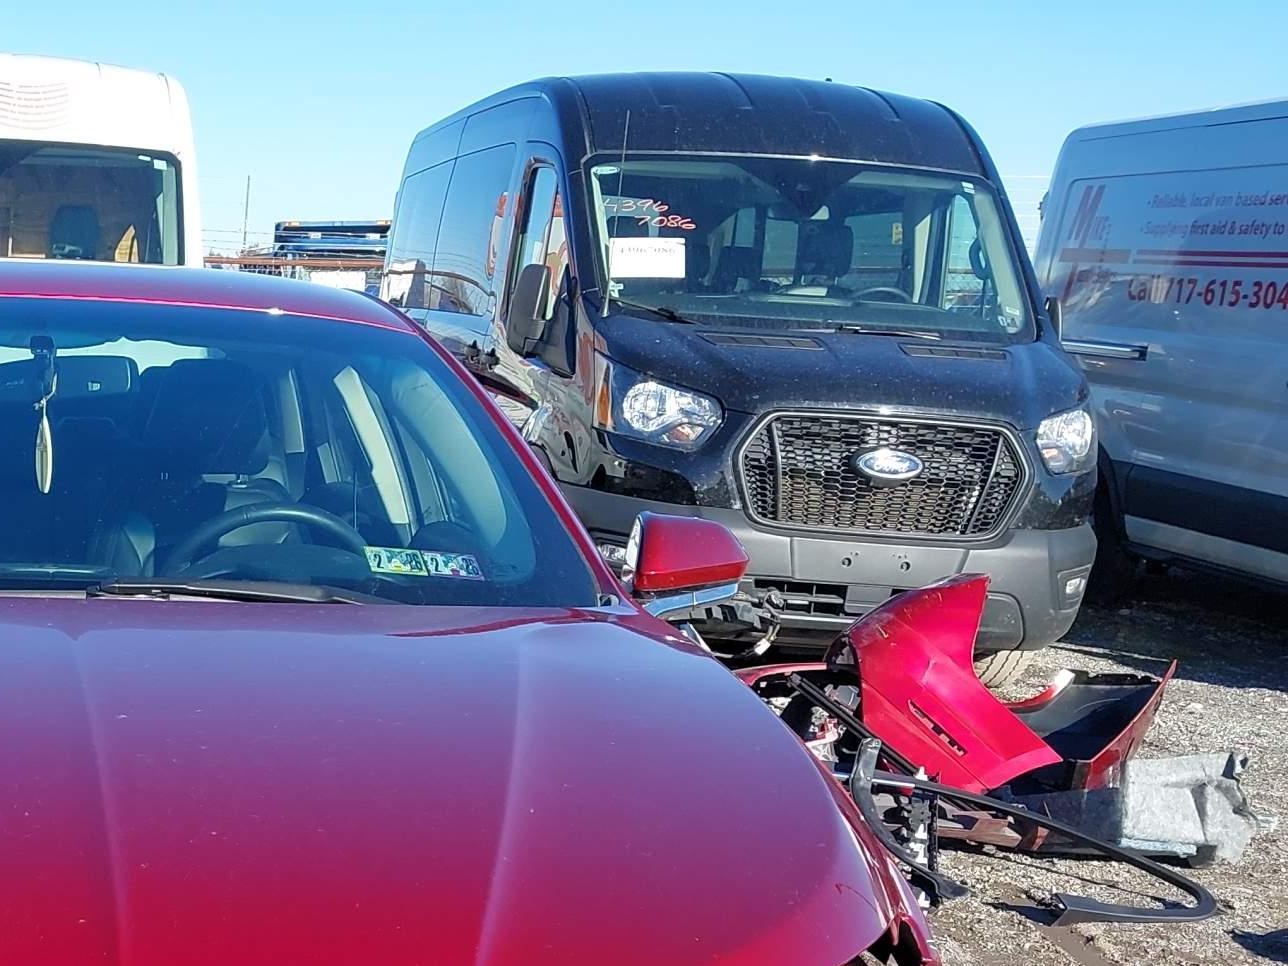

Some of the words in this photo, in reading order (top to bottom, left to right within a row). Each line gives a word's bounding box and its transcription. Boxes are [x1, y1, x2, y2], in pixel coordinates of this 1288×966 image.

[603, 198, 668, 213] 4396
[1191, 192, 1215, 206] local
[1216, 195, 1234, 206] van
[1236, 191, 1269, 206] based
[1269, 193, 1288, 206] ser
[634, 215, 697, 231] 7086
[1190, 220, 1210, 235] first
[1210, 220, 1227, 235] aid
[1228, 221, 1236, 235] &
[1238, 219, 1272, 239] safety
[1272, 221, 1286, 235] to
